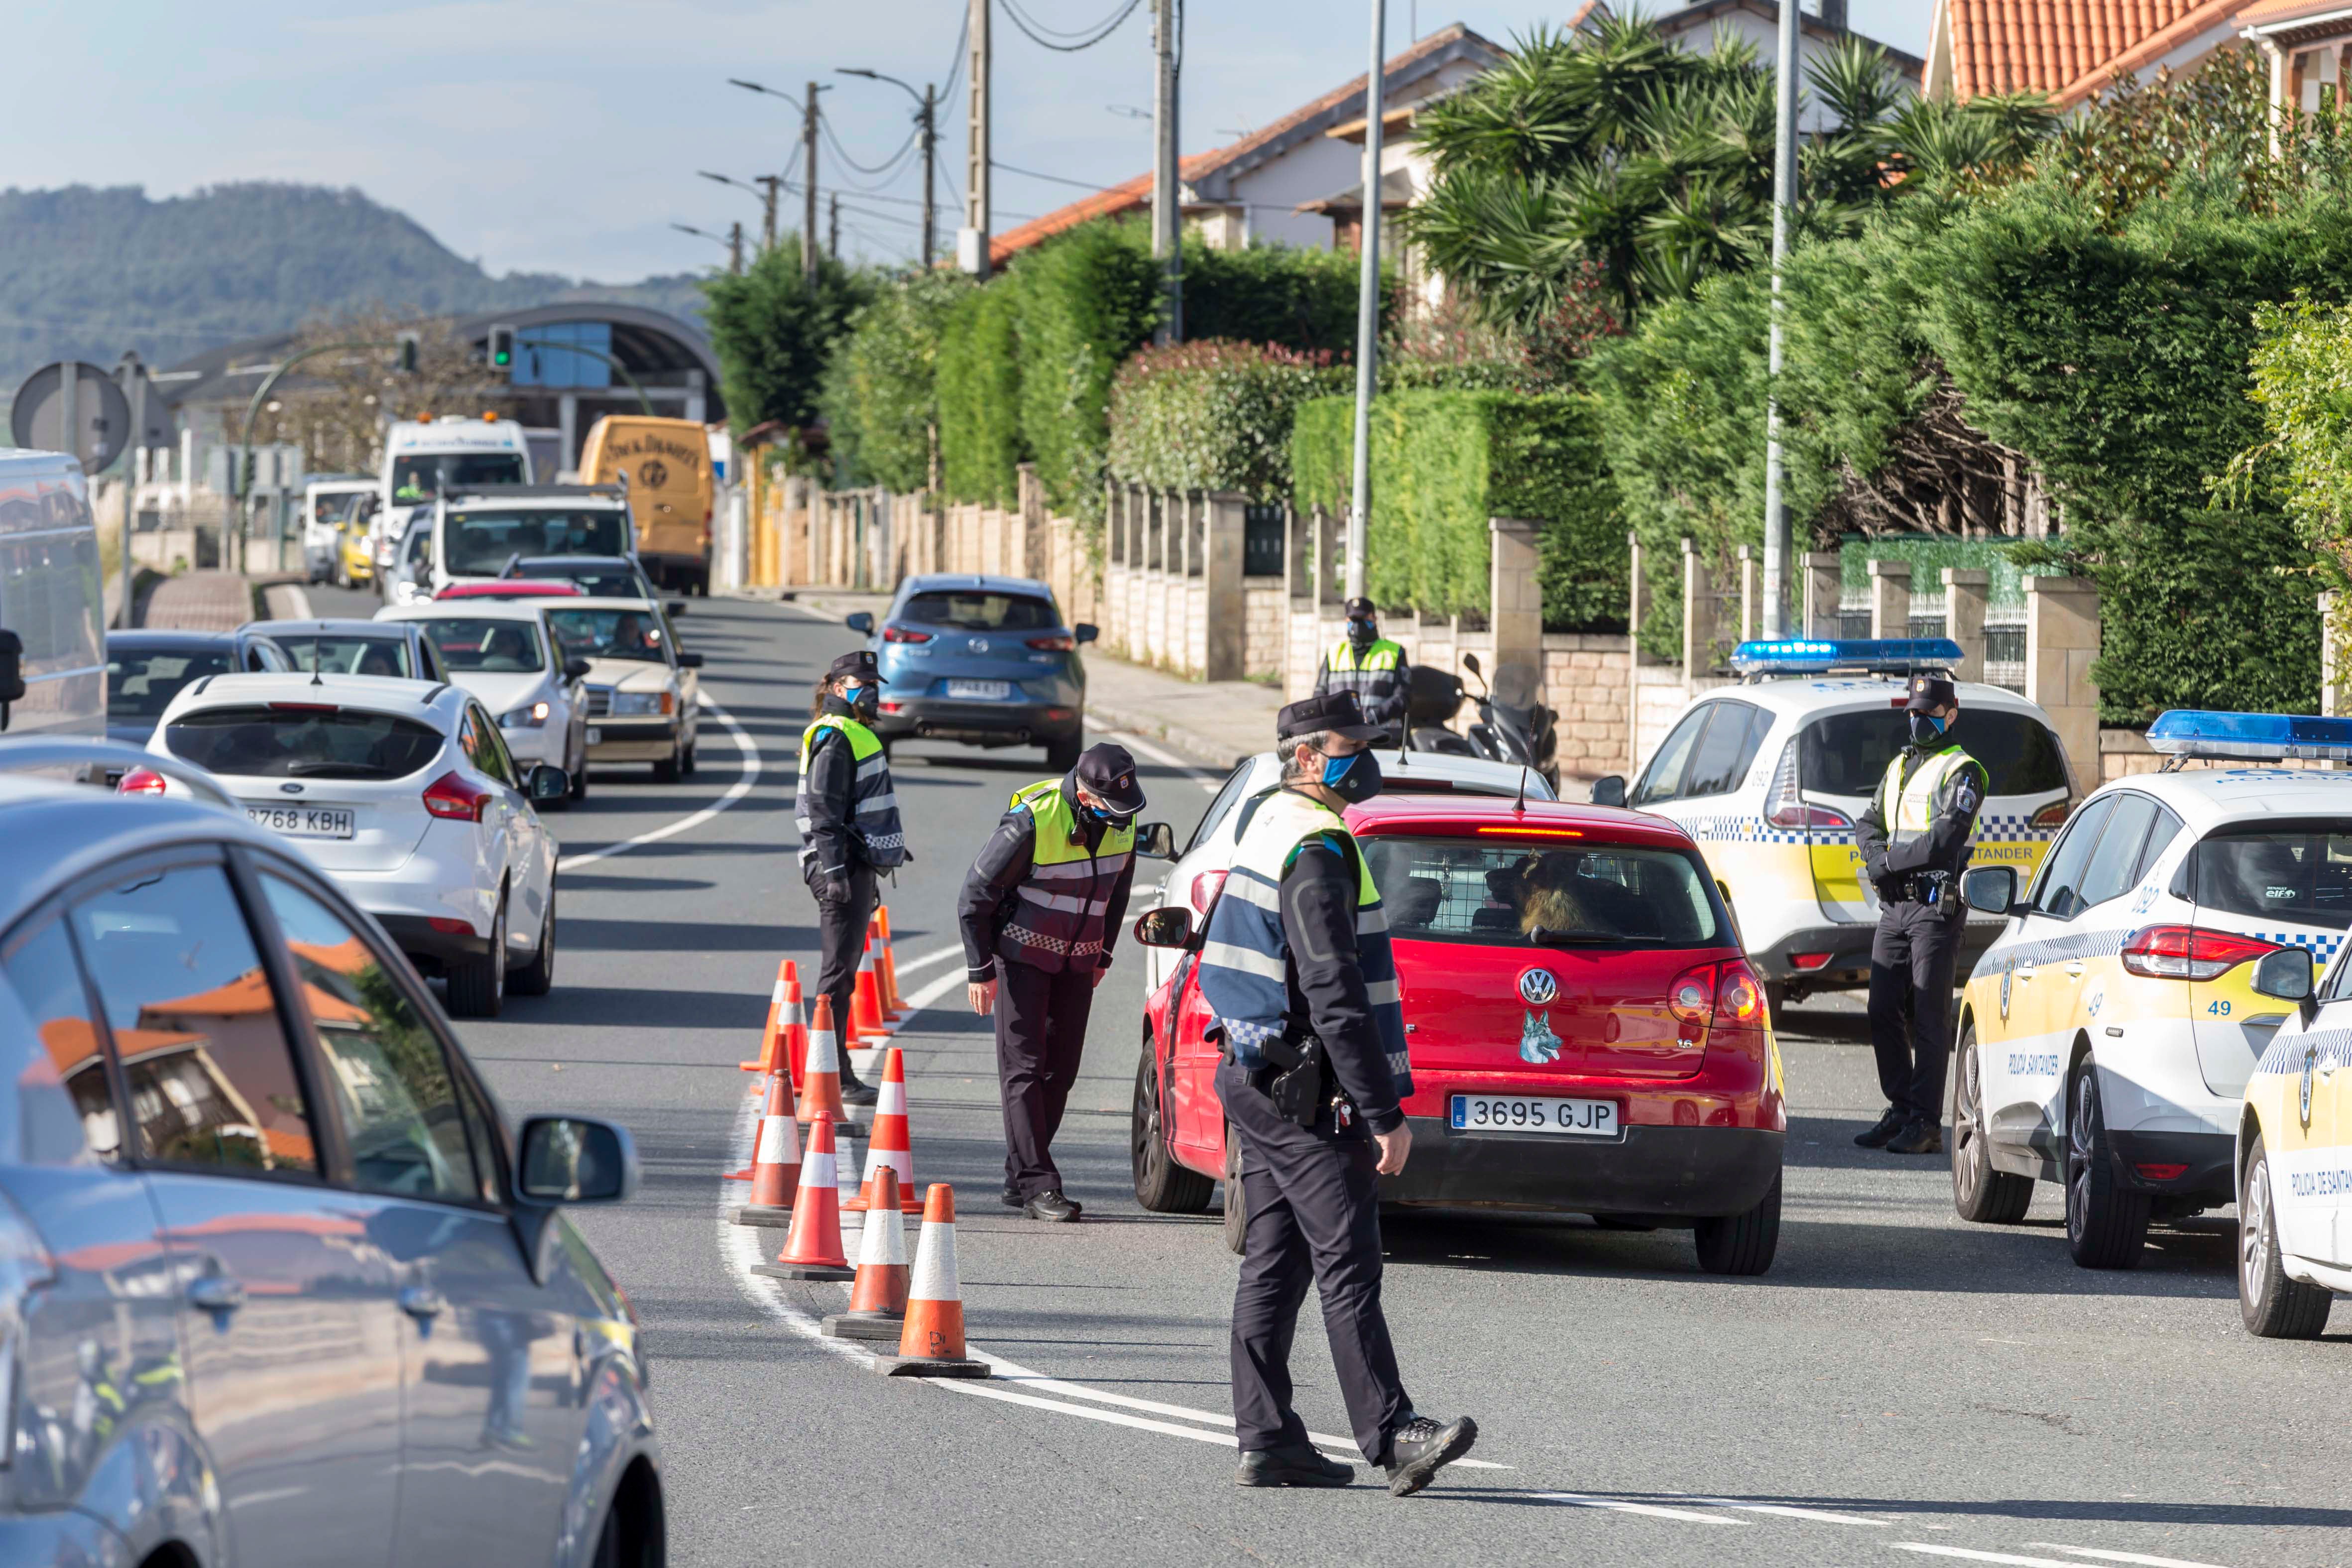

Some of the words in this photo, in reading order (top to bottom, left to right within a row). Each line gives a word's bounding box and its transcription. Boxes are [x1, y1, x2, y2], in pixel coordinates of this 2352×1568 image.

[1752, 770, 1769, 787] 092
[307, 812, 347, 831] KBH
[2131, 885, 2159, 914] 092
[2088, 992, 2103, 1017] 49
[2207, 1000, 2231, 1016] 49
[1676, 1038, 1693, 1049] 1.6
[2026, 1054, 2058, 1076] SANTANDER
[1473, 1100, 1545, 1127] 3695
[1557, 1103, 1610, 1129] GJP
[2291, 1173, 2316, 1197] POLICIA
[2318, 1171, 2327, 1195] DE
